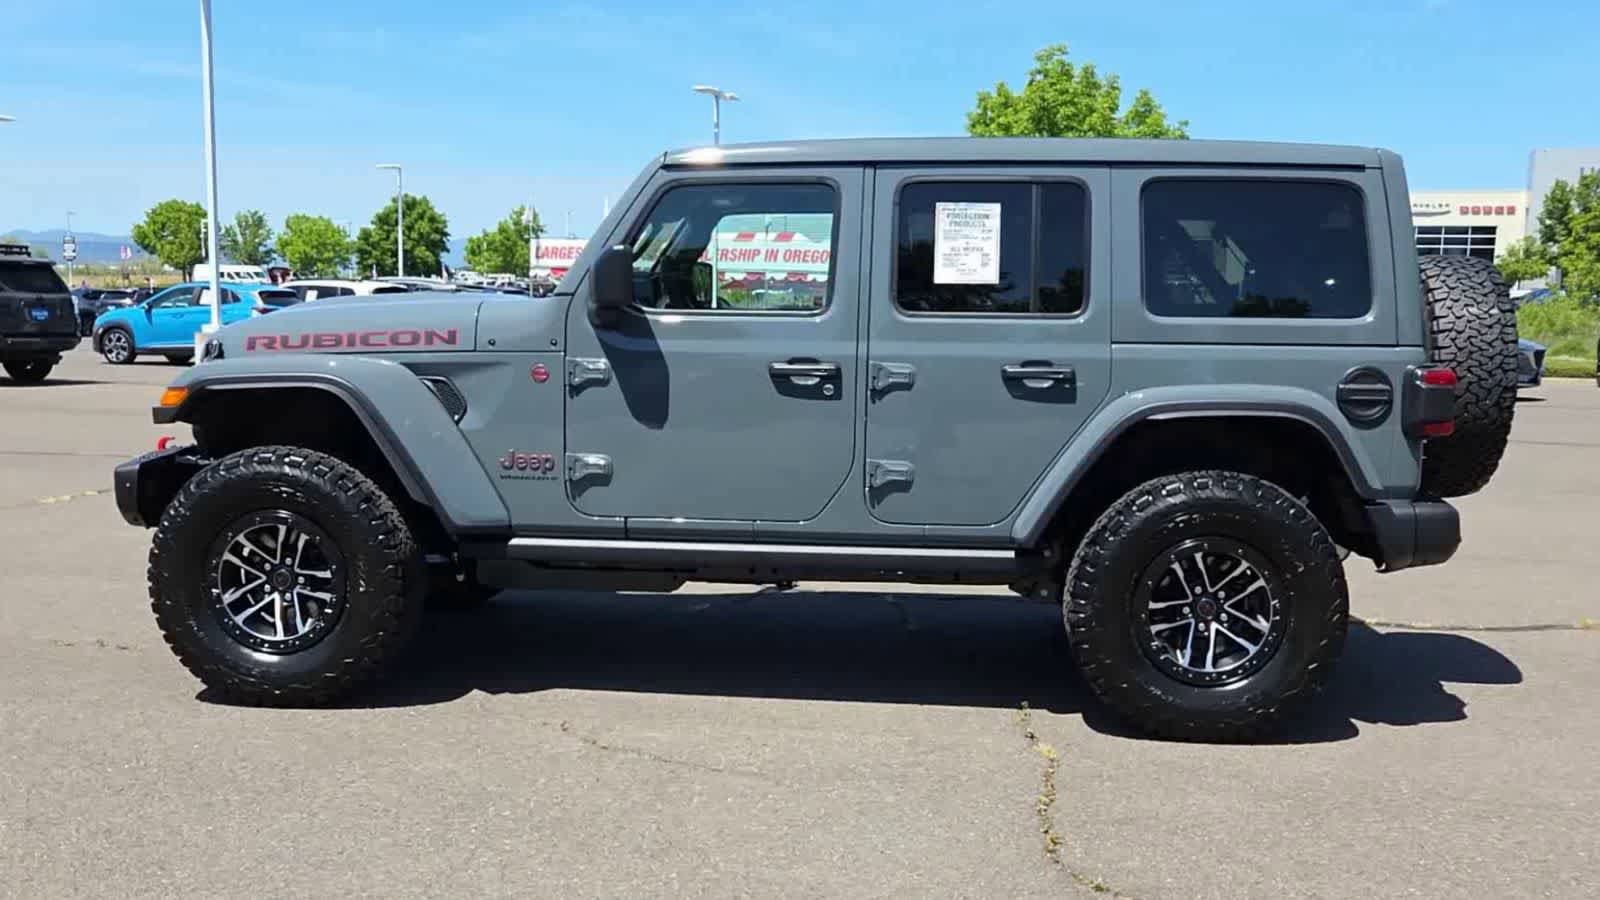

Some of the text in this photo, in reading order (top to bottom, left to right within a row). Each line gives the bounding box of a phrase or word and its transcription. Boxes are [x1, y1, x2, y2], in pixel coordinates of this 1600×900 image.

[764, 248, 779, 262] IN
[246, 329, 458, 351] RUBICON
[500, 449, 555, 475] Jeep
